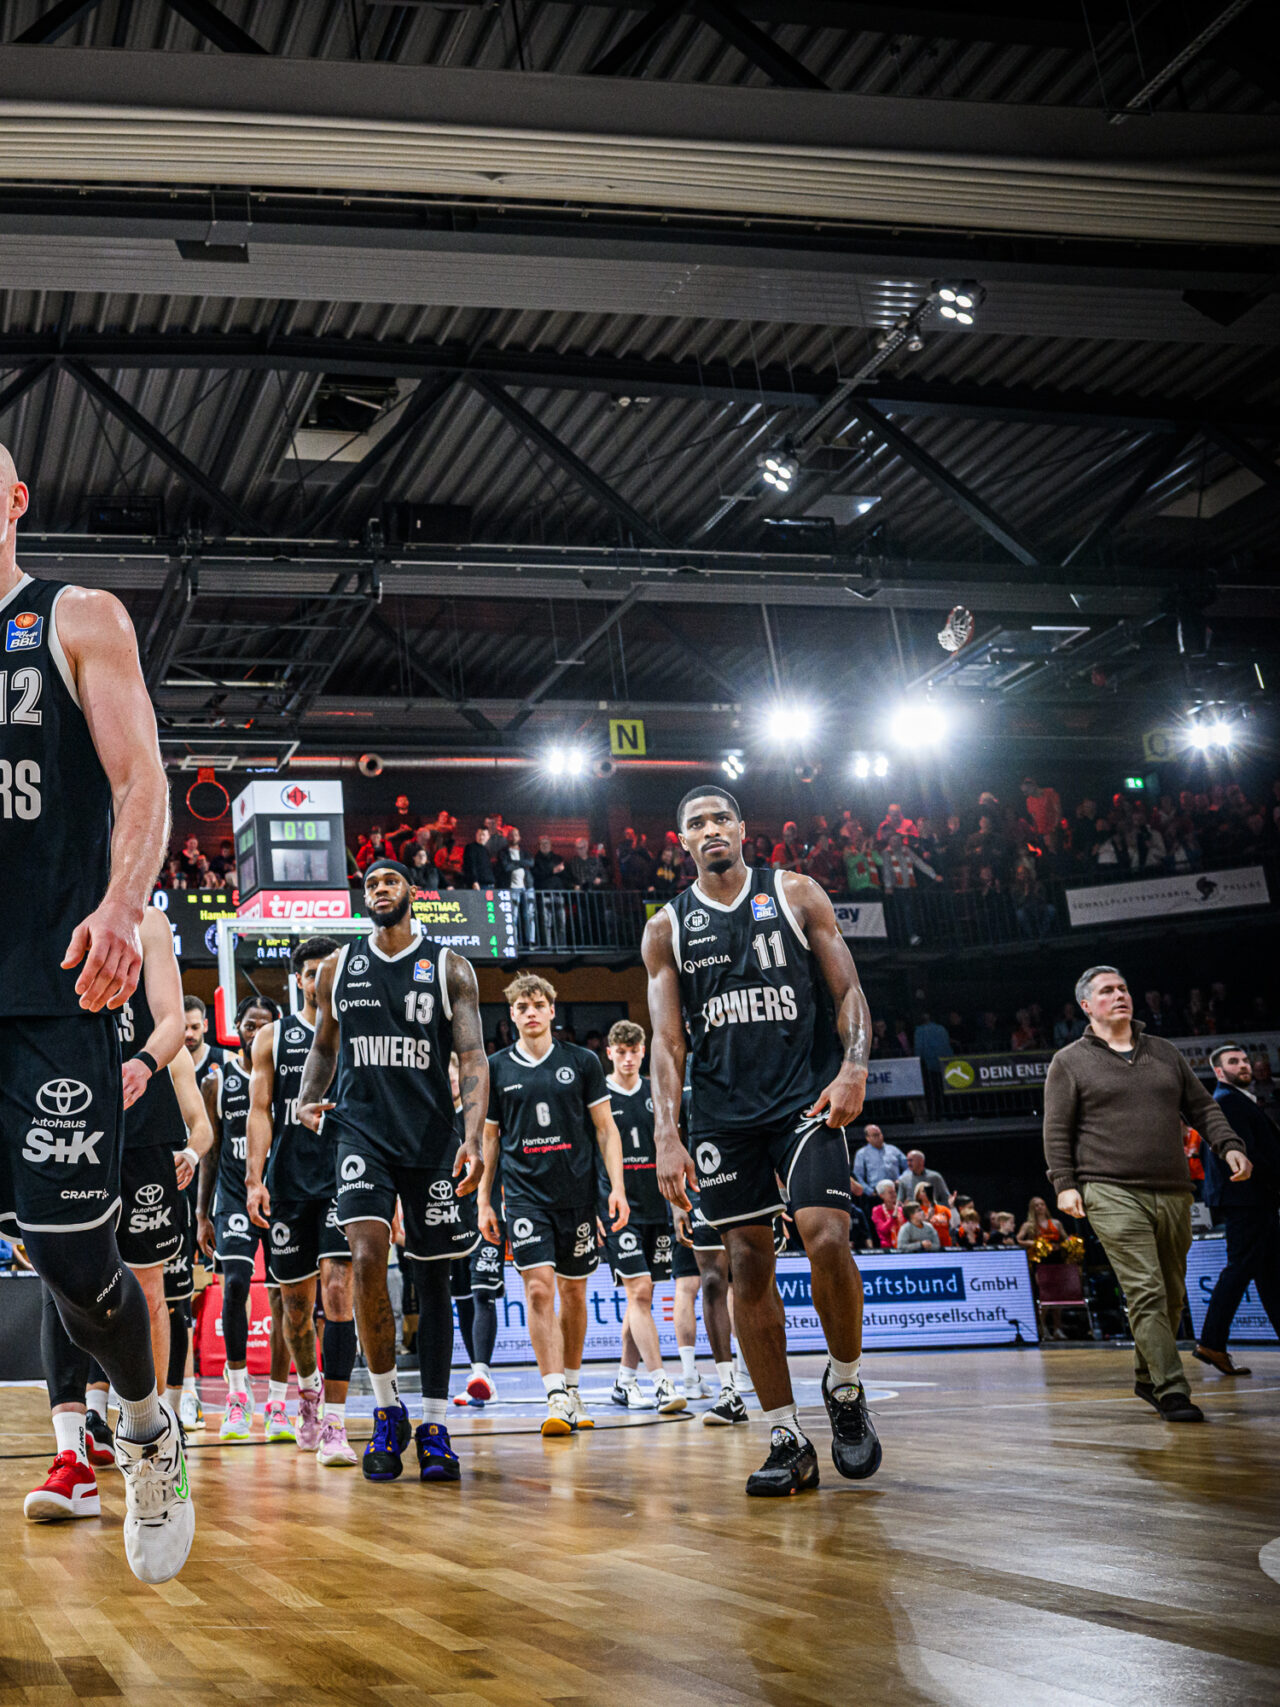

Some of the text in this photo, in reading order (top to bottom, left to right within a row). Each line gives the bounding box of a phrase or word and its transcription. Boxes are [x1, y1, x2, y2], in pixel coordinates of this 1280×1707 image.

[10, 637, 37, 648] BBL
[617, 724, 638, 749] N
[269, 894, 346, 919] tipico
[486, 901, 495, 912] 2
[487, 913, 496, 924] 2
[489, 935, 498, 946] 4
[688, 936, 712, 947] CRAFT
[752, 930, 787, 970] 11
[695, 953, 732, 969] VEOLIA
[348, 999, 382, 1008] VEOLIA
[404, 990, 435, 1025] 13
[350, 1035, 431, 1070] TOWERS
[979, 1065, 1013, 1080] DEIN
[31, 1116, 87, 1129] Autohaus
[535, 1102, 552, 1128] 6
[522, 1135, 562, 1147] Hamburger
[630, 1126, 640, 1149] 1
[22, 1128, 105, 1165] S+K
[60, 1190, 103, 1200] CRAFT
[131, 1204, 163, 1215] Autohaus
[424, 1204, 462, 1227] S+K
[128, 1206, 172, 1234] S+K
[96, 1271, 120, 1303] CRAFT
[970, 1276, 1019, 1292] GmbH
